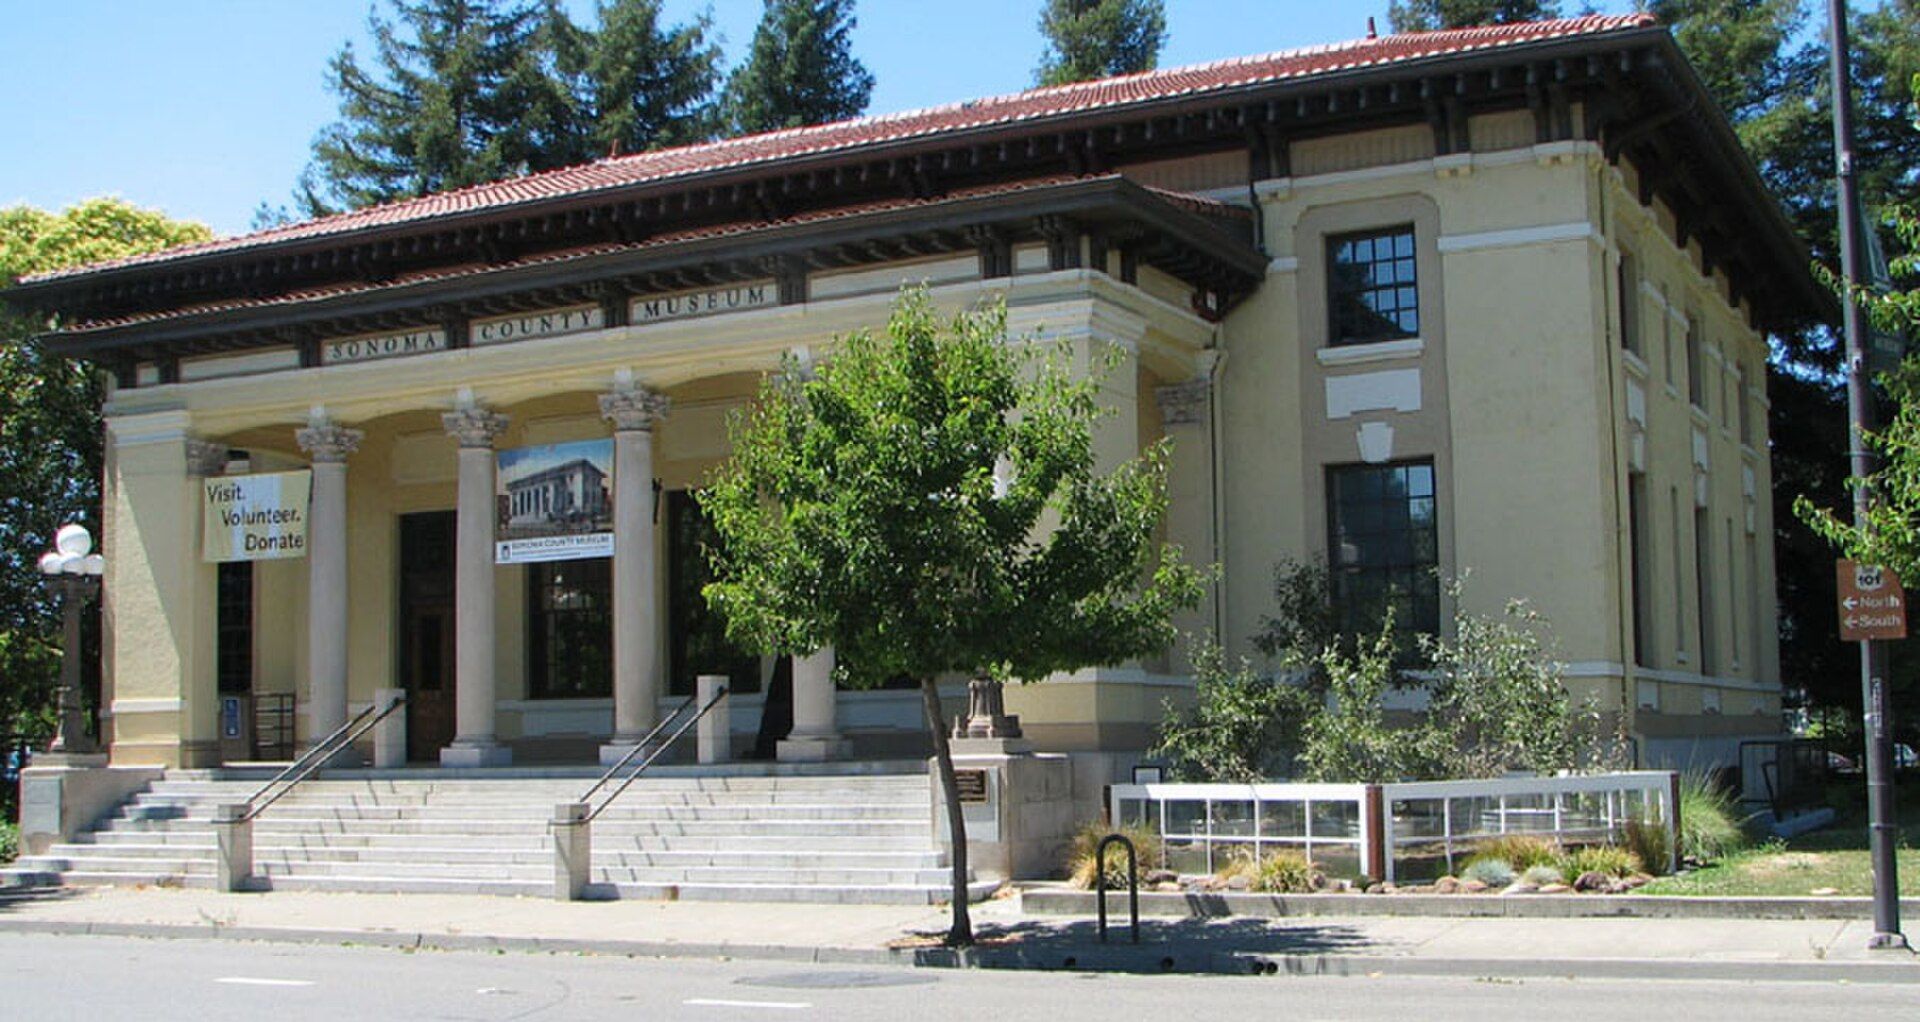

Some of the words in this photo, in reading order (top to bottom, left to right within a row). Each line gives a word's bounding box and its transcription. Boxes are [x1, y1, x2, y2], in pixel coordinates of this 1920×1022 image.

[331, 333, 436, 360] SONOMA
[481, 308, 592, 340] COUNTY
[644, 286, 766, 319] MUSEUM
[207, 482, 246, 503] Visit.
[221, 506, 301, 527] Volunteer.
[244, 532, 304, 552] Donate
[1858, 574, 1880, 587] 101
[1860, 595, 1900, 608] North
[1860, 615, 1901, 627] South
